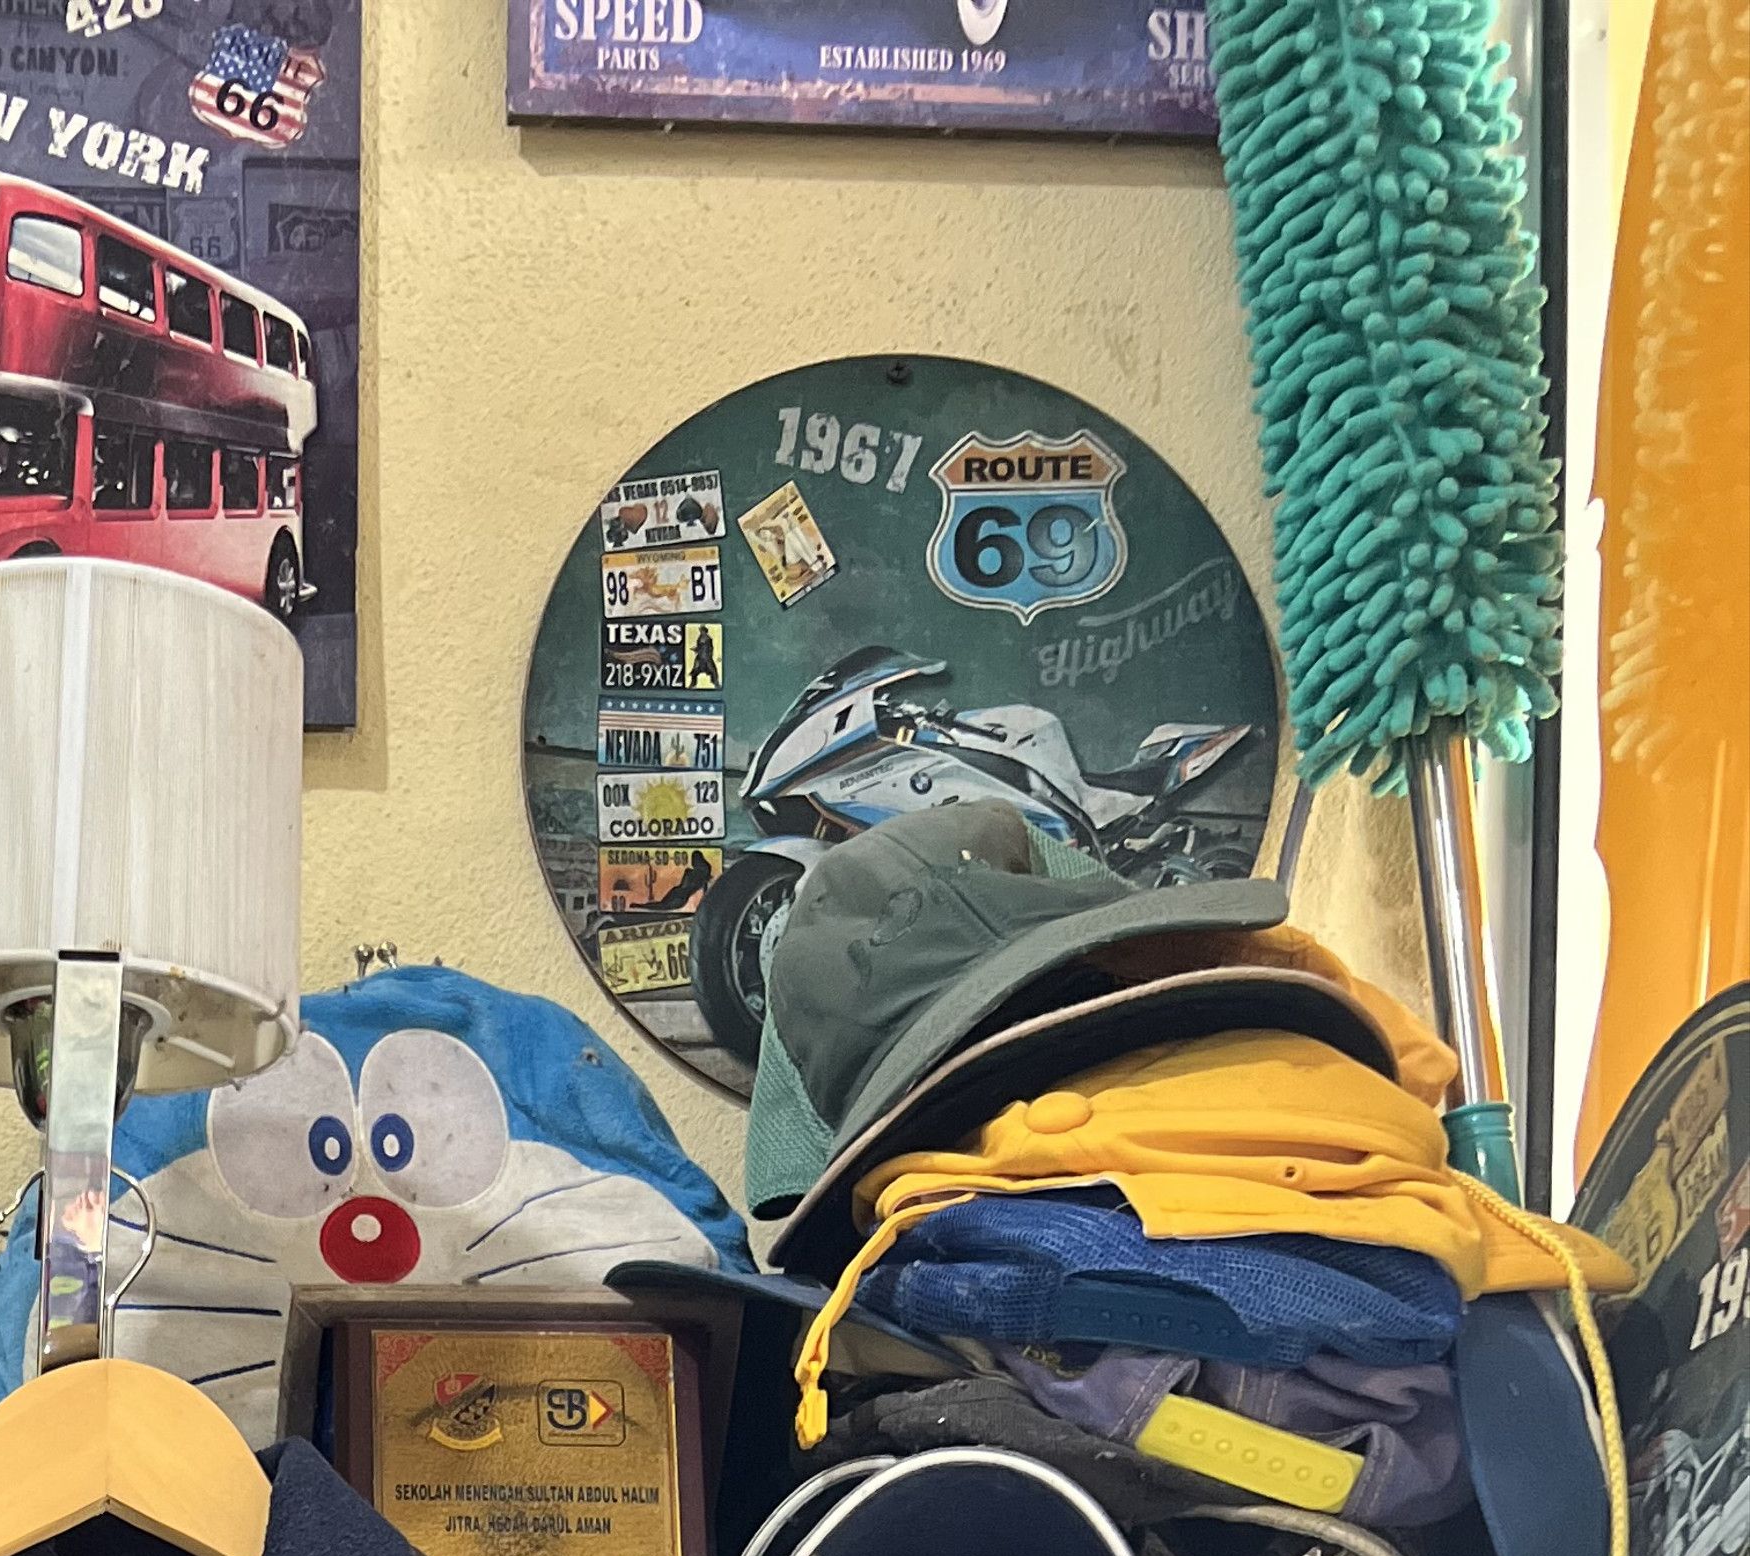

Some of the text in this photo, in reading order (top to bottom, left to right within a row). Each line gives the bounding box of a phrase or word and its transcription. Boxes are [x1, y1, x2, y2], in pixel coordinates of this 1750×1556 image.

[554, 0, 703, 43] SPEED
[10, 46, 118, 77] CANYON
[596, 47, 660, 71] PARTS
[819, 45, 1007, 73] ESTABLISHED 1969
[215, 78, 285, 132] 66
[47, 106, 210, 194] YORK
[775, 406, 923, 494] 1967
[963, 454, 1093, 484] ROUTE
[954, 503, 1100, 589] 69
[607, 565, 718, 606] 98 BT
[606, 623, 683, 644] TEXAS
[1038, 569, 1241, 688] Highway
[605, 729, 718, 768] NEVADA 751
[694, 780, 719, 803] 123
[610, 817, 714, 837] COLORADO
[394, 1484, 659, 1504] SEKOLAH MENENGAH SULTAN ABDUL HALIM
[575, 1517, 611, 1534] AMAN
